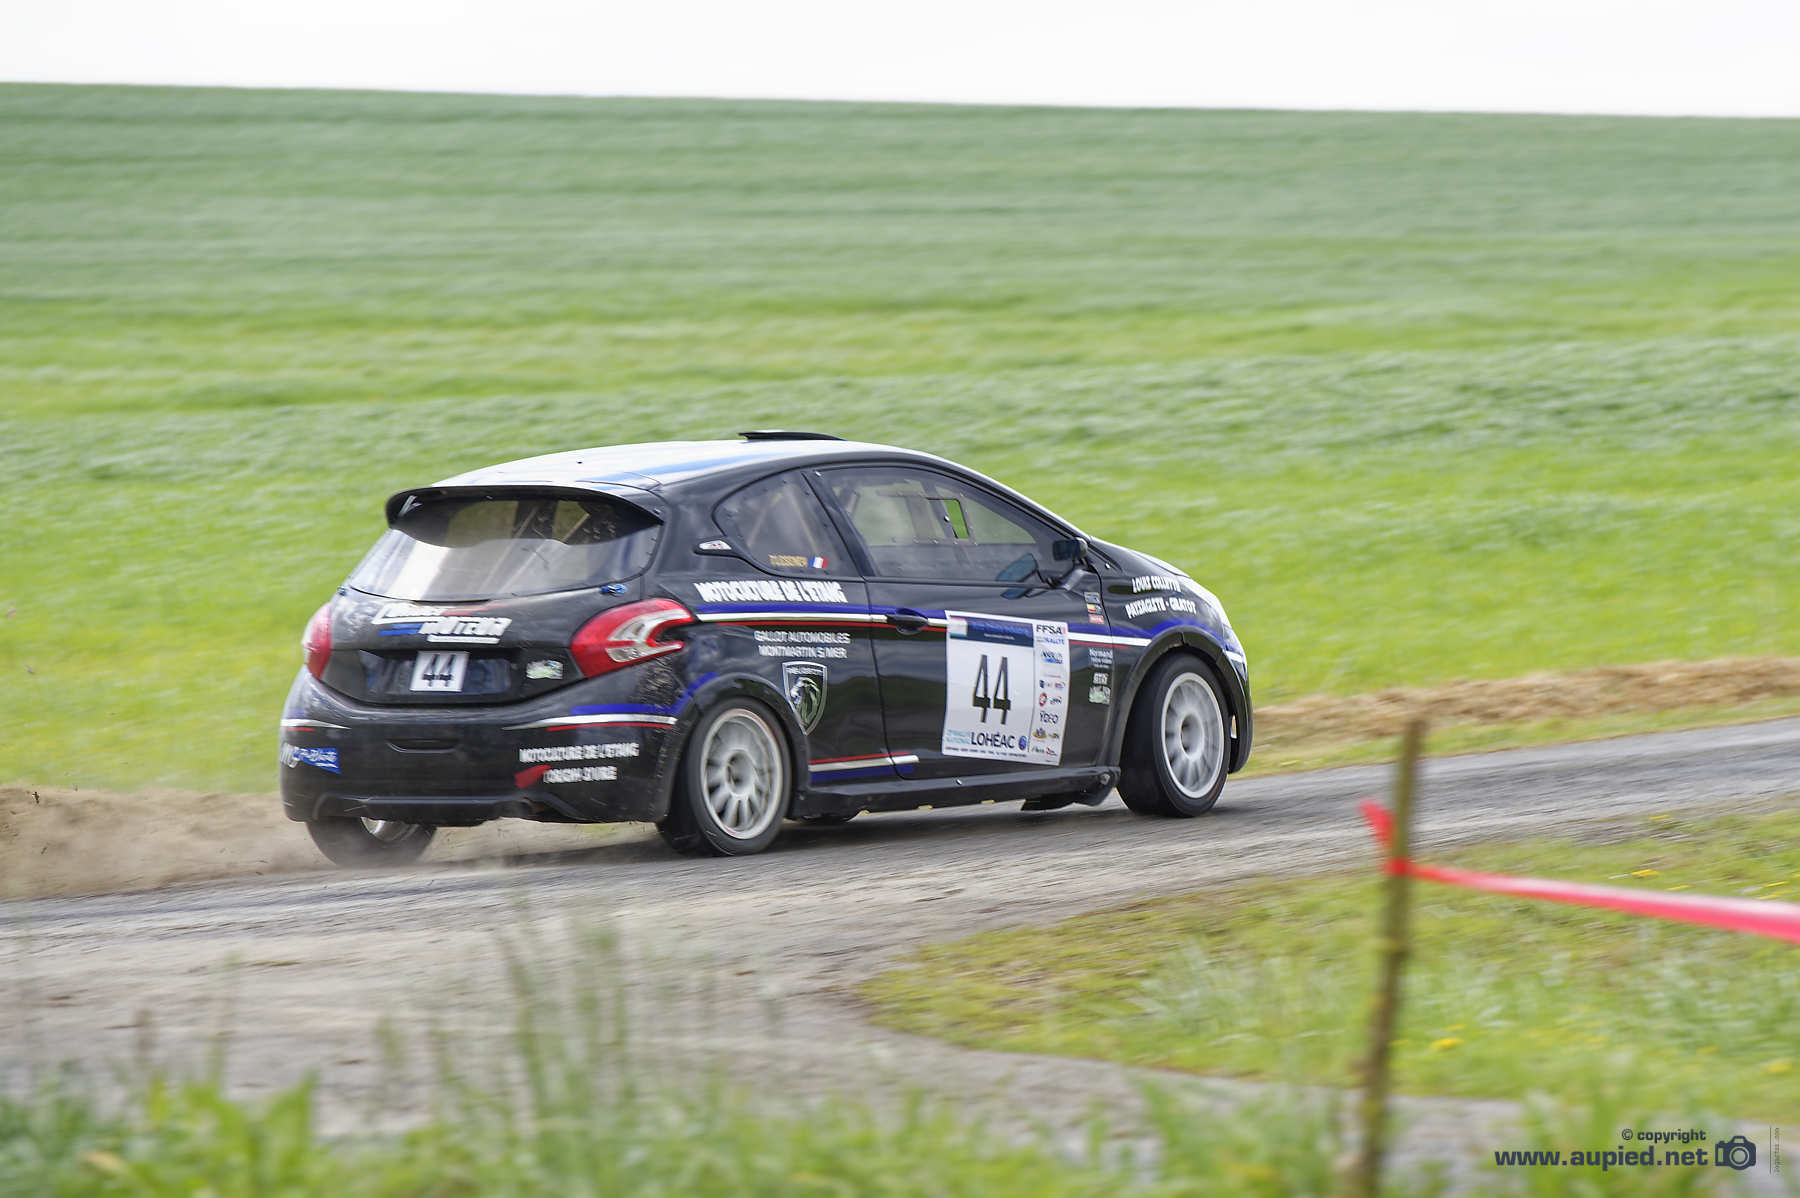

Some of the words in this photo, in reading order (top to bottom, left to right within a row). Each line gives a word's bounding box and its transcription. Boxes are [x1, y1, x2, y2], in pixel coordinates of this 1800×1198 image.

[788, 631, 851, 644] AUTOMOBILES
[1036, 624, 1062, 635] FFSA
[422, 653, 457, 688] 44
[972, 654, 1011, 725] 44
[971, 731, 1016, 749] LOHÉAC
